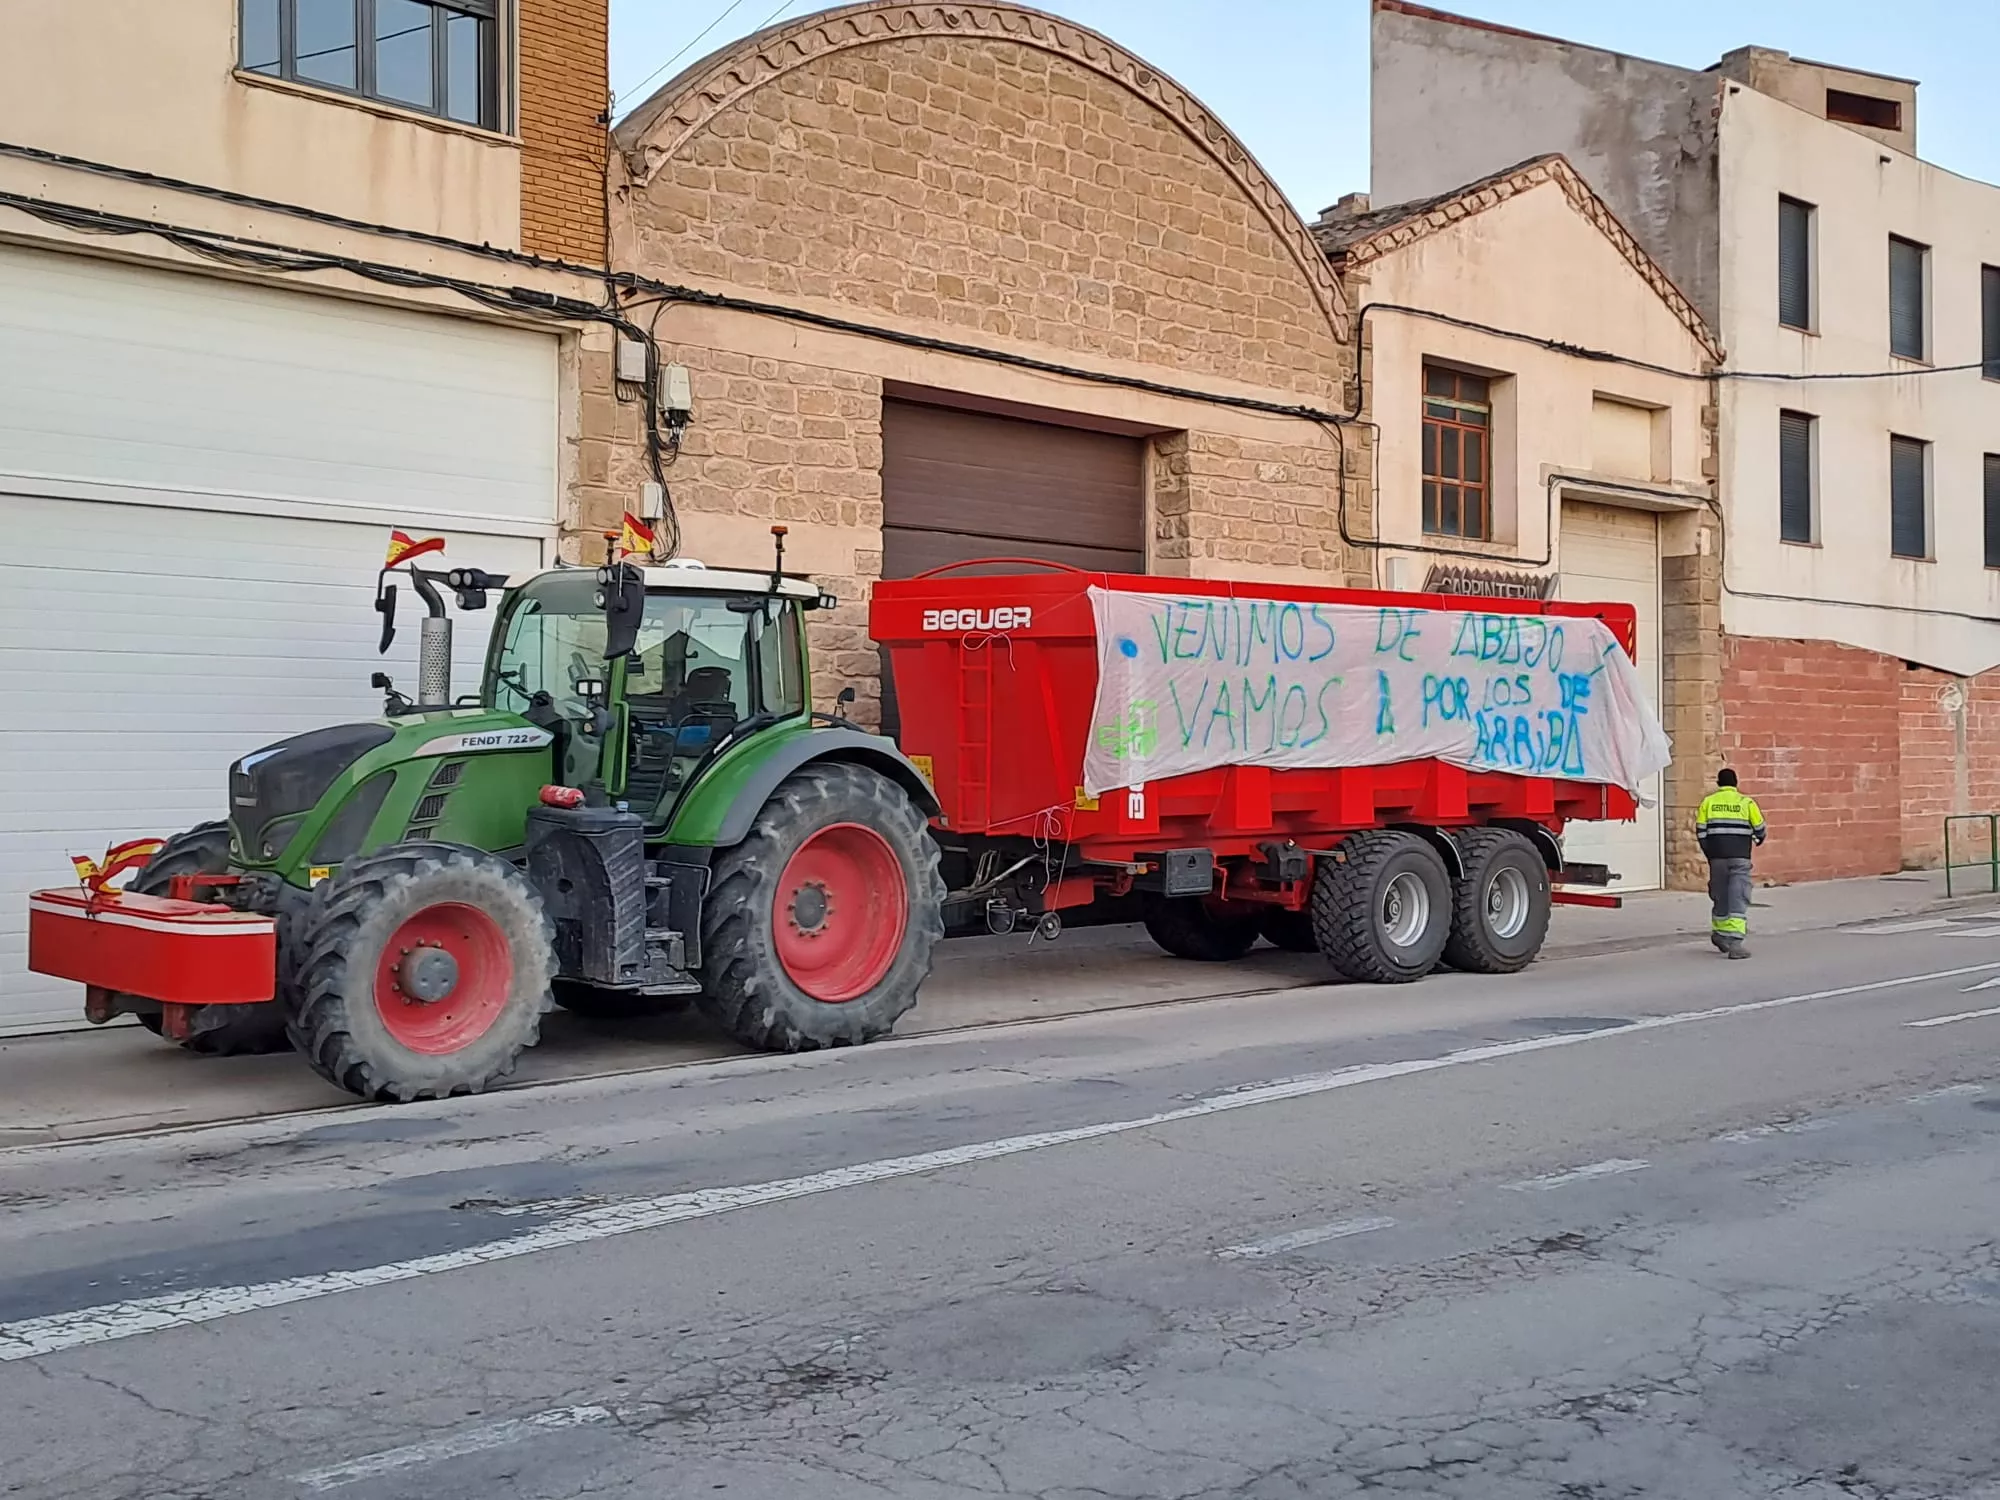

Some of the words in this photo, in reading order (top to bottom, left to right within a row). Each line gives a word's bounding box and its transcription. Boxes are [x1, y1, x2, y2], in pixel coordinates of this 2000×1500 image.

[1151, 601, 1335, 666] VENIMOS
[1374, 608, 1429, 662] DE
[1450, 612, 1564, 673] ABAJO
[461, 735, 502, 747] FENDT
[507, 734, 529, 744] 722
[1169, 673, 1345, 754] VAMOS
[1422, 672, 1472, 728] POR
[1482, 674, 1532, 712] LOS
[1557, 672, 1592, 715] DE
